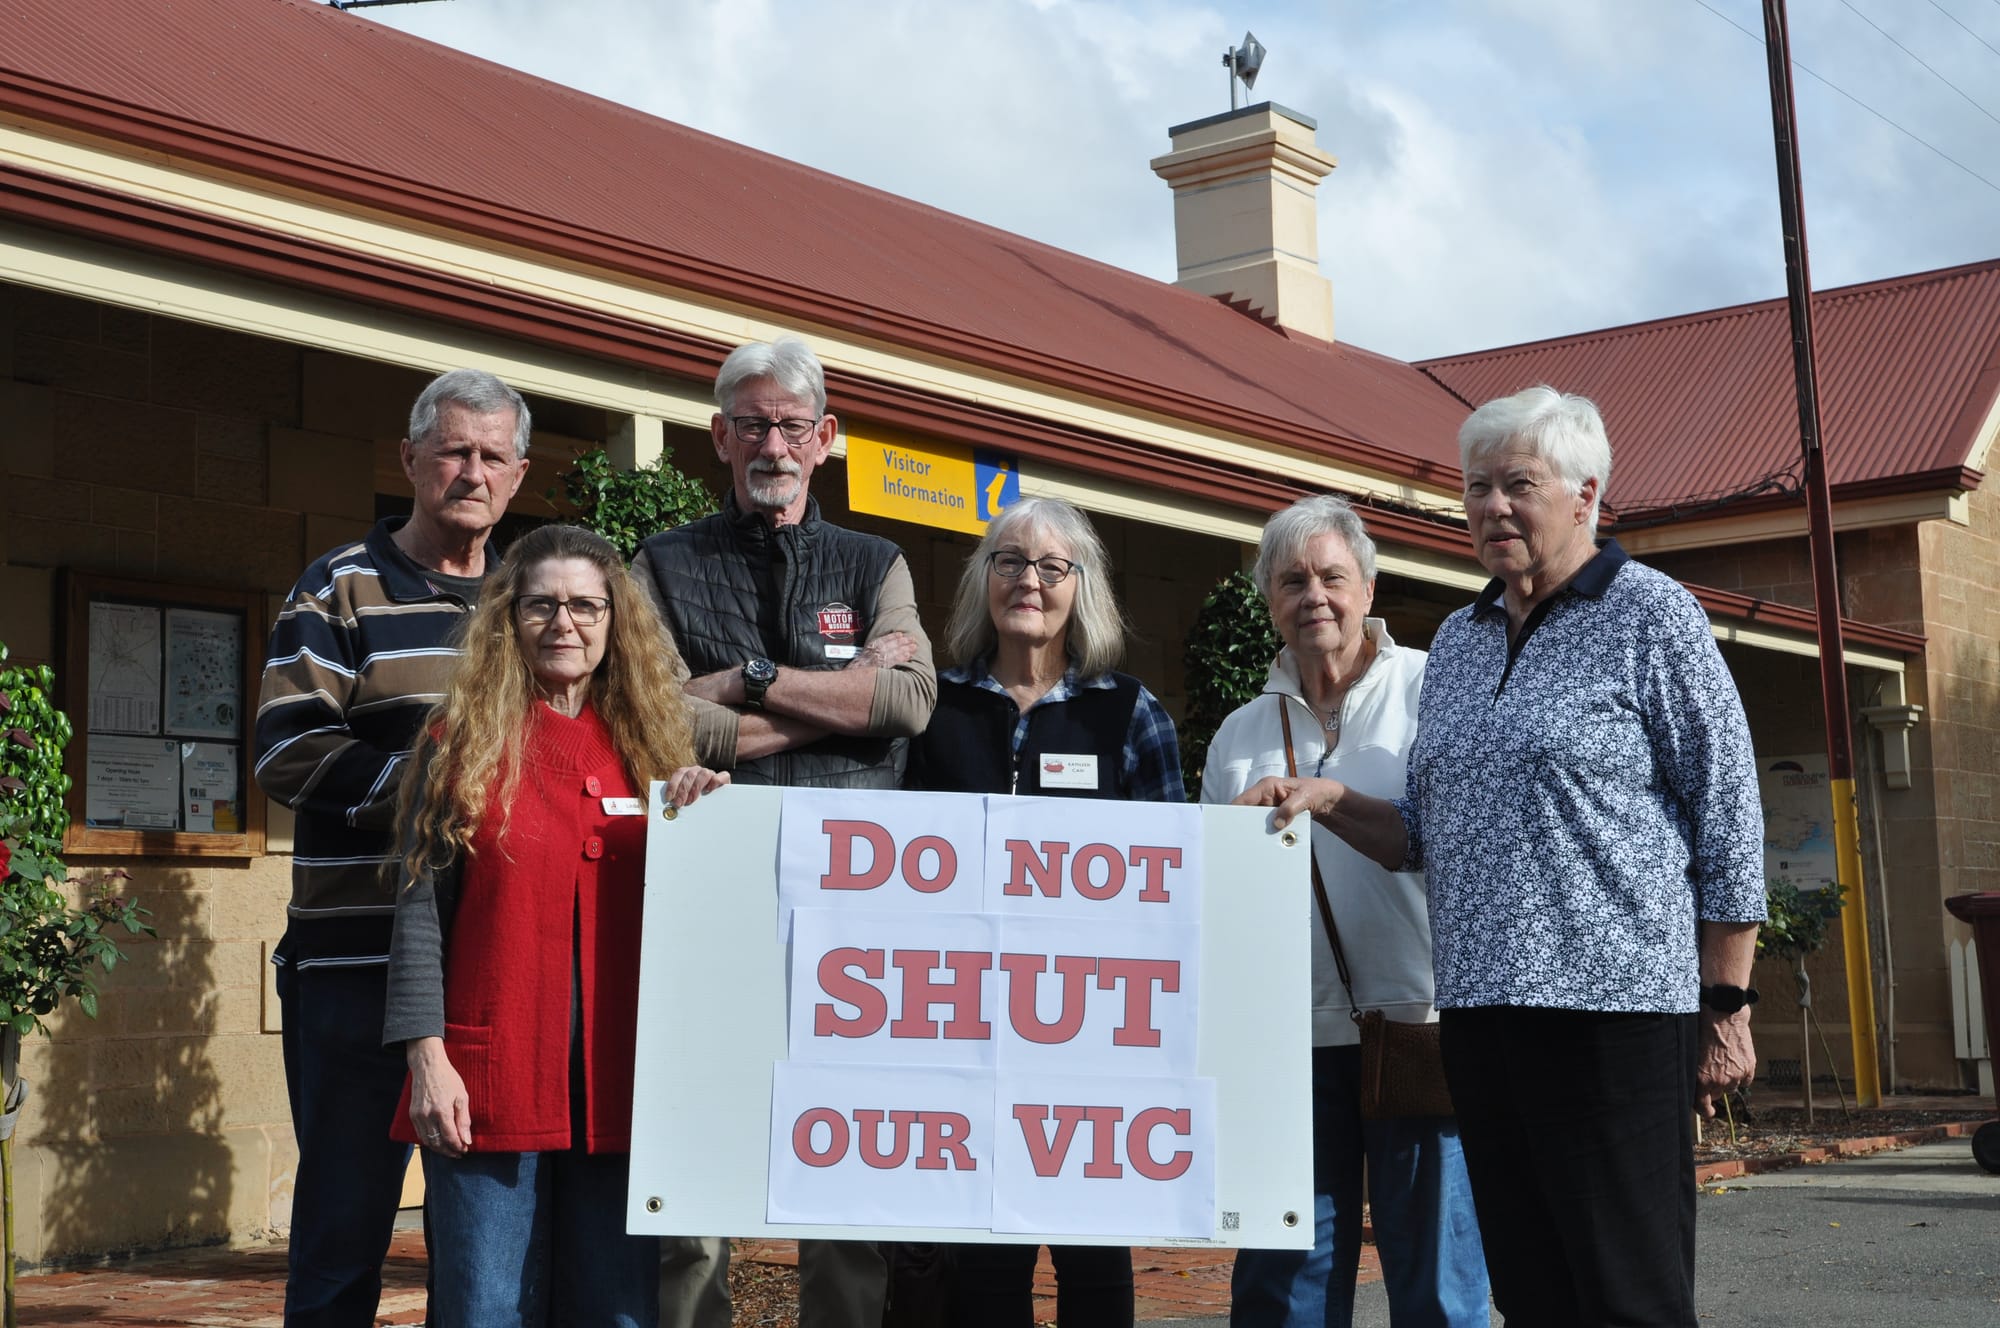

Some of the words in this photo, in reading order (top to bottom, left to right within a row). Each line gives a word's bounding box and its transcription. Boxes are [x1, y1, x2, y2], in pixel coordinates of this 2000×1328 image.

[883, 448, 931, 476] Visitor
[883, 475, 965, 509] Information
[823, 613, 853, 624] MOTOR
[1003, 839, 1183, 903] NOT
[814, 947, 1180, 1048] SHUT
[792, 1107, 977, 1171] OUR
[1012, 1103, 1194, 1181] VIC
